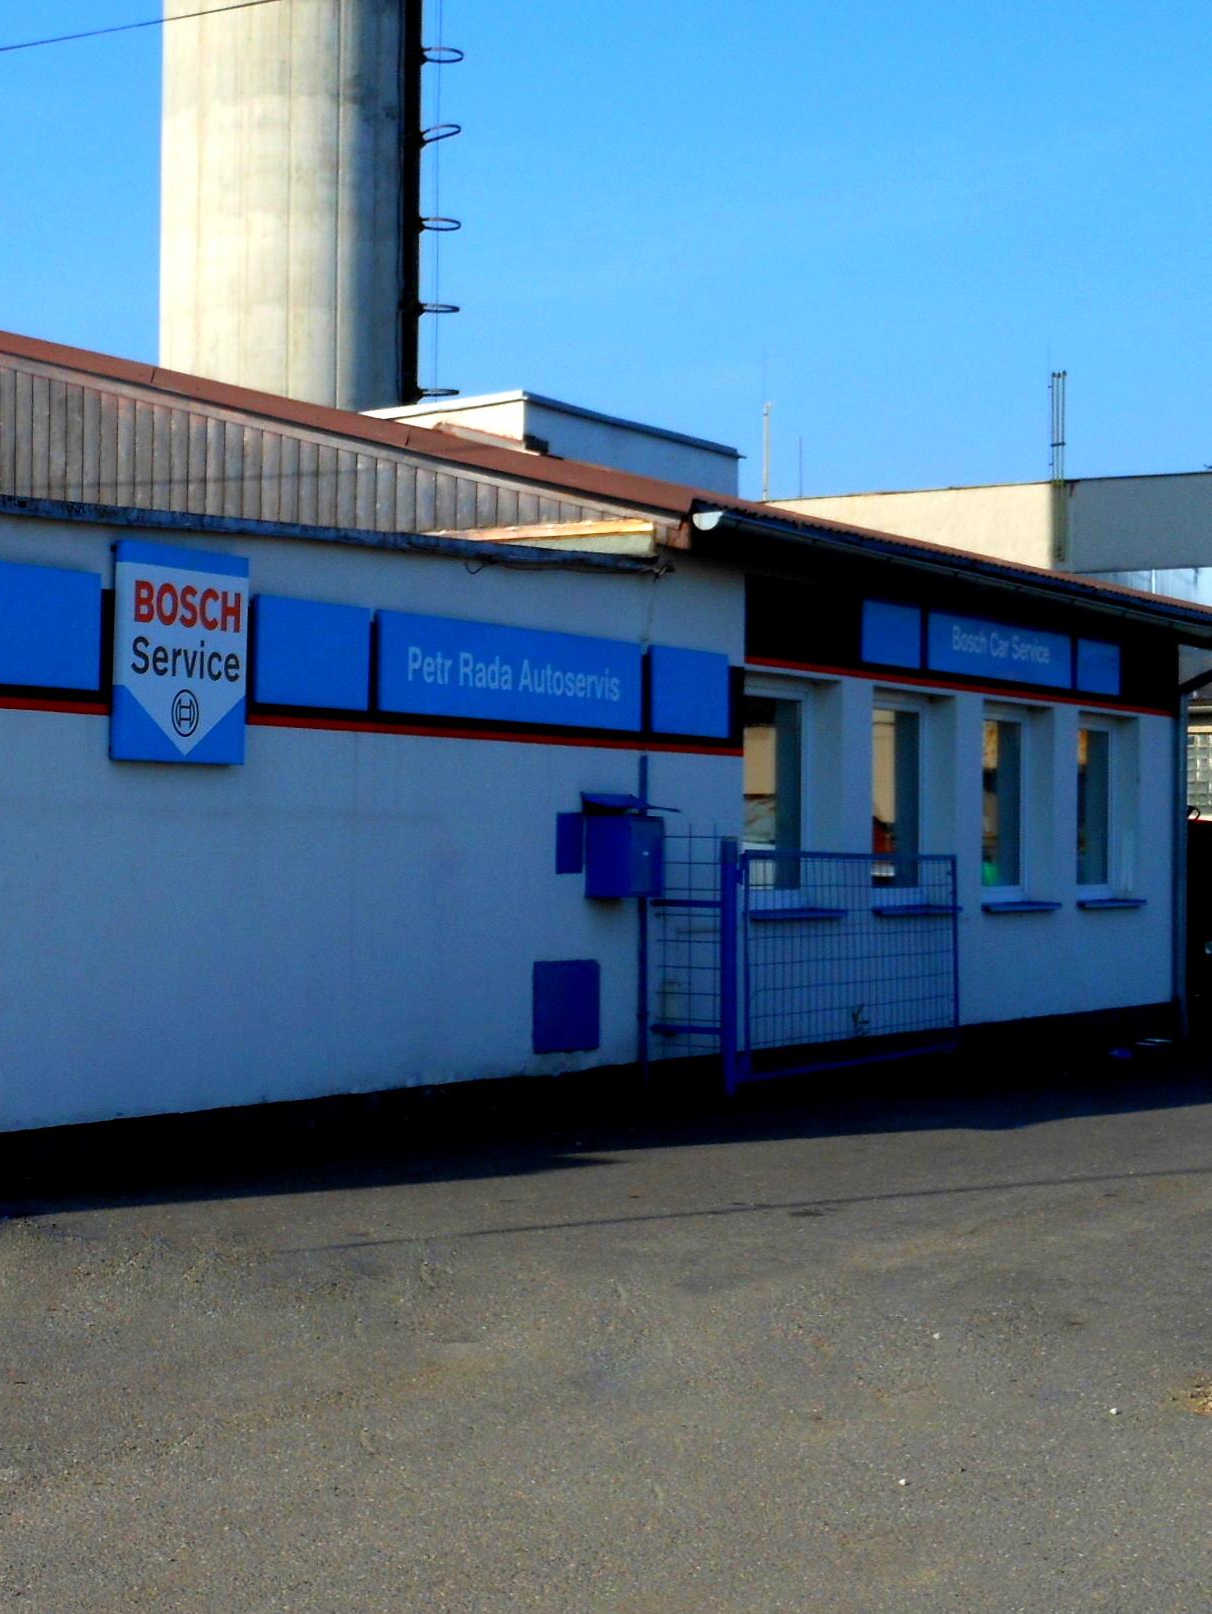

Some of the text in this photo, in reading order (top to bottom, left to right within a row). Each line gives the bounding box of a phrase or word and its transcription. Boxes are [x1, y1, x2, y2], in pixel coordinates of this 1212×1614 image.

[134, 580, 241, 633] BOSCH
[131, 636, 240, 682] Service
[952, 625, 1050, 664] Bosch Car Service
[408, 646, 621, 701] Petr Rada Autoservis
